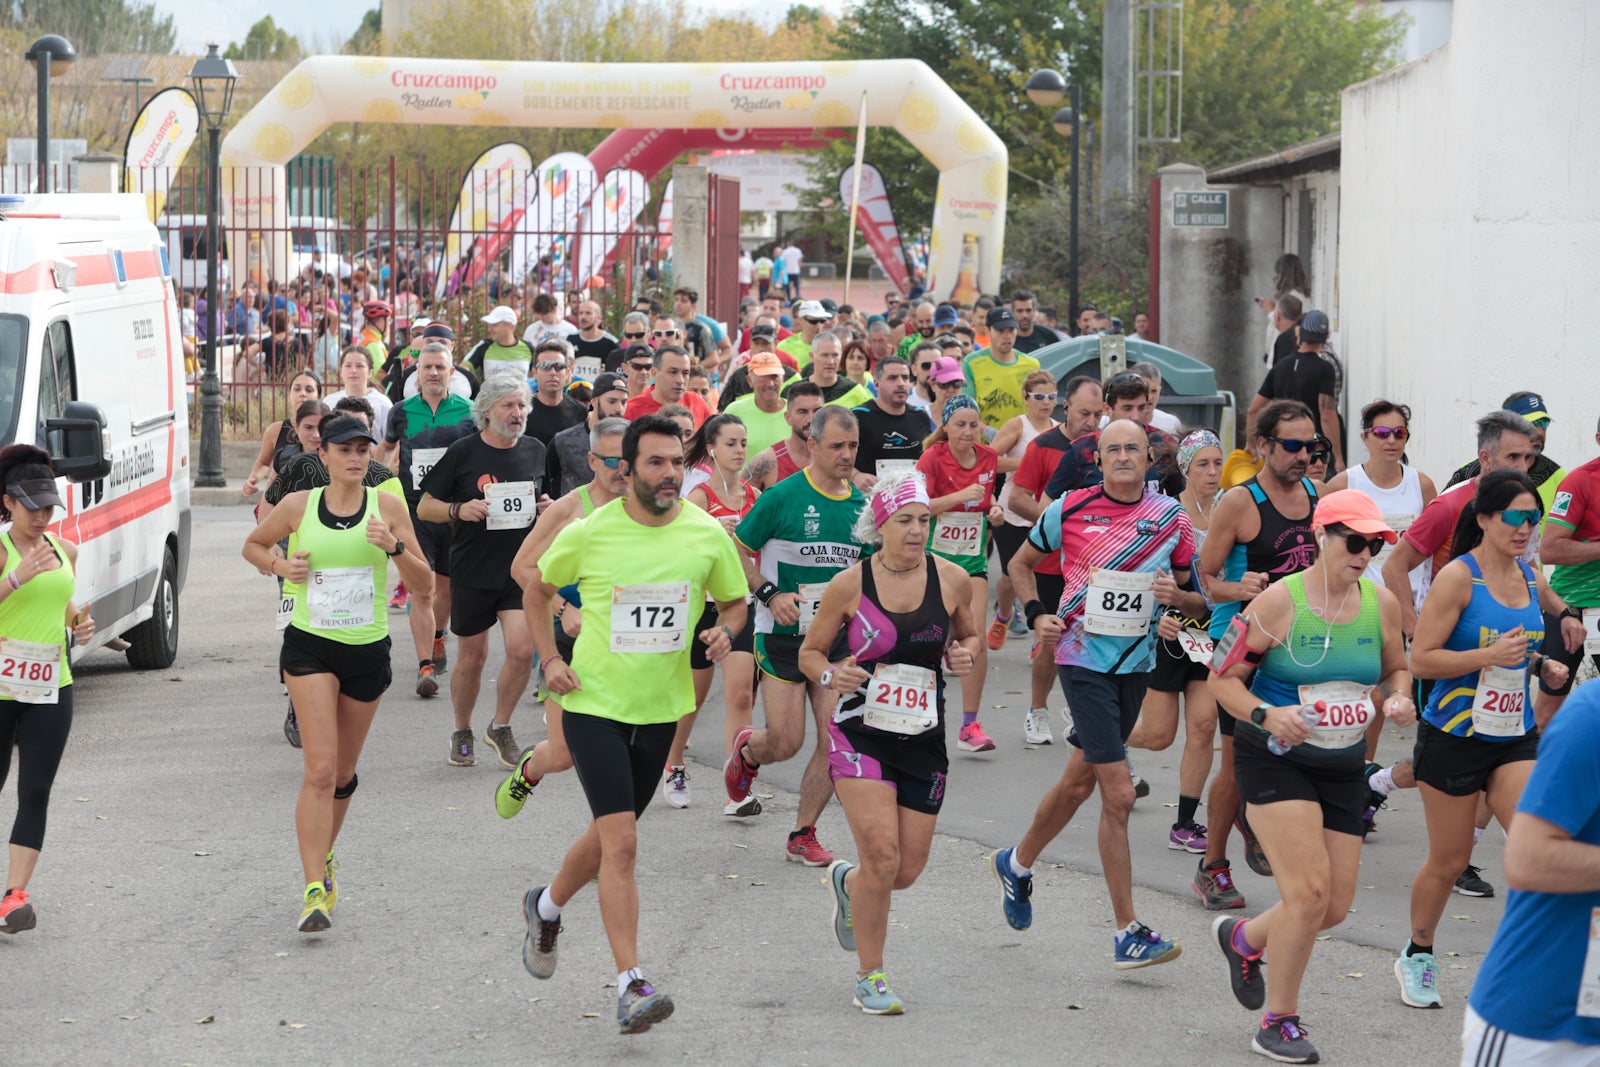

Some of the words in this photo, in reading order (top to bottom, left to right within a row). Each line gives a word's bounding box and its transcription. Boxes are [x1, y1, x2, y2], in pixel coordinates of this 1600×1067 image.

[391, 70, 497, 91] Cruzcampo
[720, 73, 825, 91] Cruzcampo
[401, 92, 454, 110] Radler
[523, 95, 602, 110] DOBLEMENTE
[605, 95, 691, 110] REFRESCANTE
[730, 95, 781, 112] Radler
[138, 110, 176, 170] Cruzcampo
[1191, 194, 1222, 204] CALLE
[576, 365, 598, 375] 3114
[503, 498, 522, 512] 89
[940, 525, 978, 541] 2012
[800, 546, 827, 556] CAJA
[815, 556, 847, 565] GRANADA
[318, 589, 366, 607] 2010
[1102, 591, 1142, 612] 824
[321, 615, 365, 627] DEPORTES
[631, 606, 675, 628] 172
[1, 658, 52, 682] 2180
[875, 683, 929, 711] 2194
[1482, 690, 1523, 713] 2082
[1315, 703, 1368, 727] 2086
